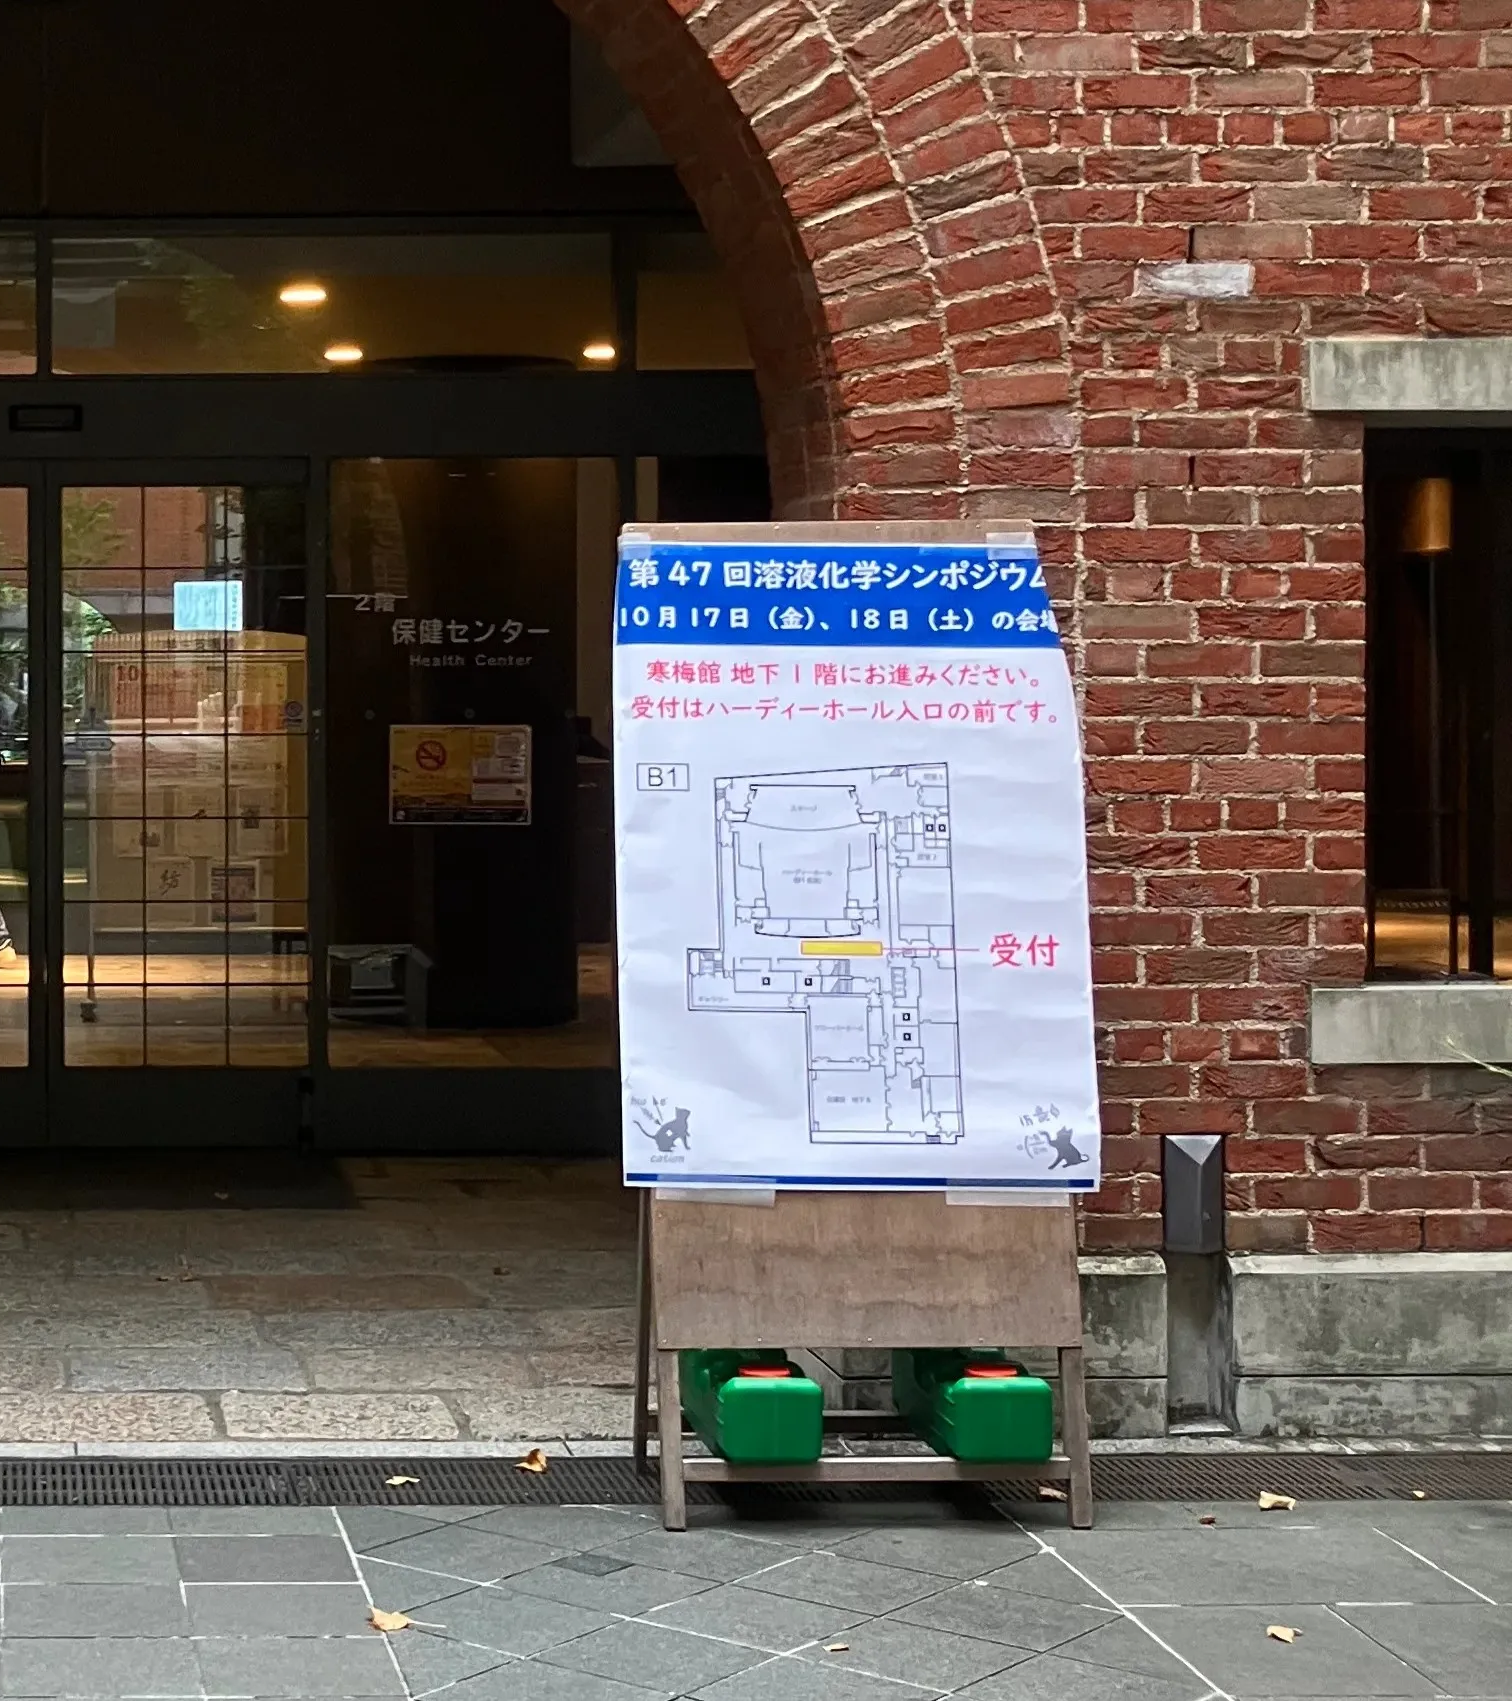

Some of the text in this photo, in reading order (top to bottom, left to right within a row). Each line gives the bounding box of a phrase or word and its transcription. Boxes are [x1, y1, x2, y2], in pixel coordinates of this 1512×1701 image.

[392, 618, 550, 644] 保健センター
[409, 654, 533, 667] Health Center
[646, 659, 722, 684] 寒梅館
[631, 694, 1058, 724] 受付はハーディーホール入口の前です。
[647, 766, 677, 787] B1
[990, 933, 1060, 967] 受付
